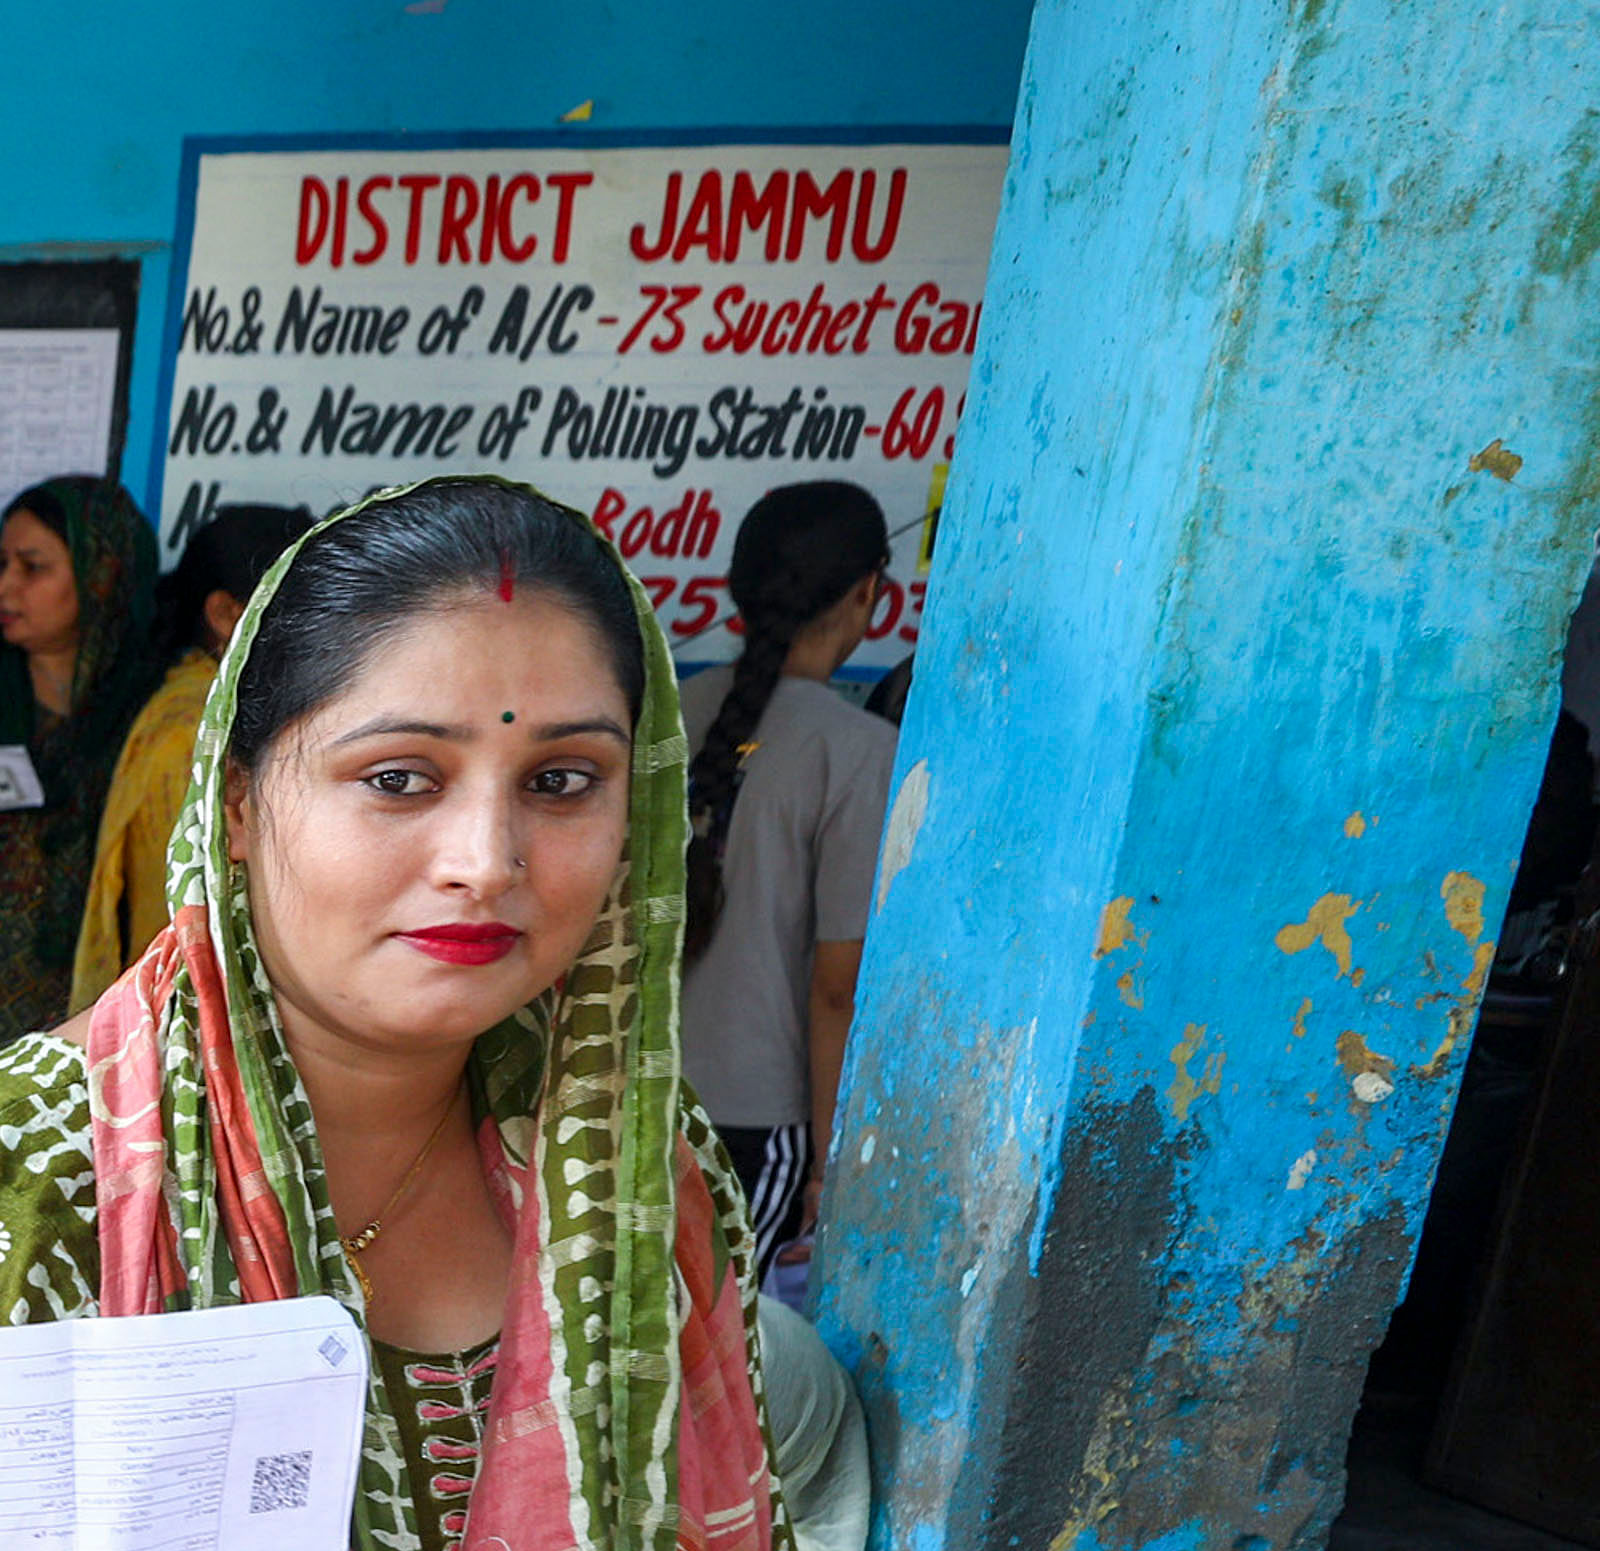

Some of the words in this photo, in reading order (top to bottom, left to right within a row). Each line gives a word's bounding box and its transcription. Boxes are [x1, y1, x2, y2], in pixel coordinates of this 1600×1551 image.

[296, 171, 594, 269] DISTRICT
[630, 167, 908, 264] JAMMU
[274, 284, 411, 356] Name
[416, 284, 485, 356] of
[702, 283, 896, 356] Suchet
[301, 383, 475, 458] Name
[477, 384, 543, 462] of
[541, 385, 700, 479] Polling
